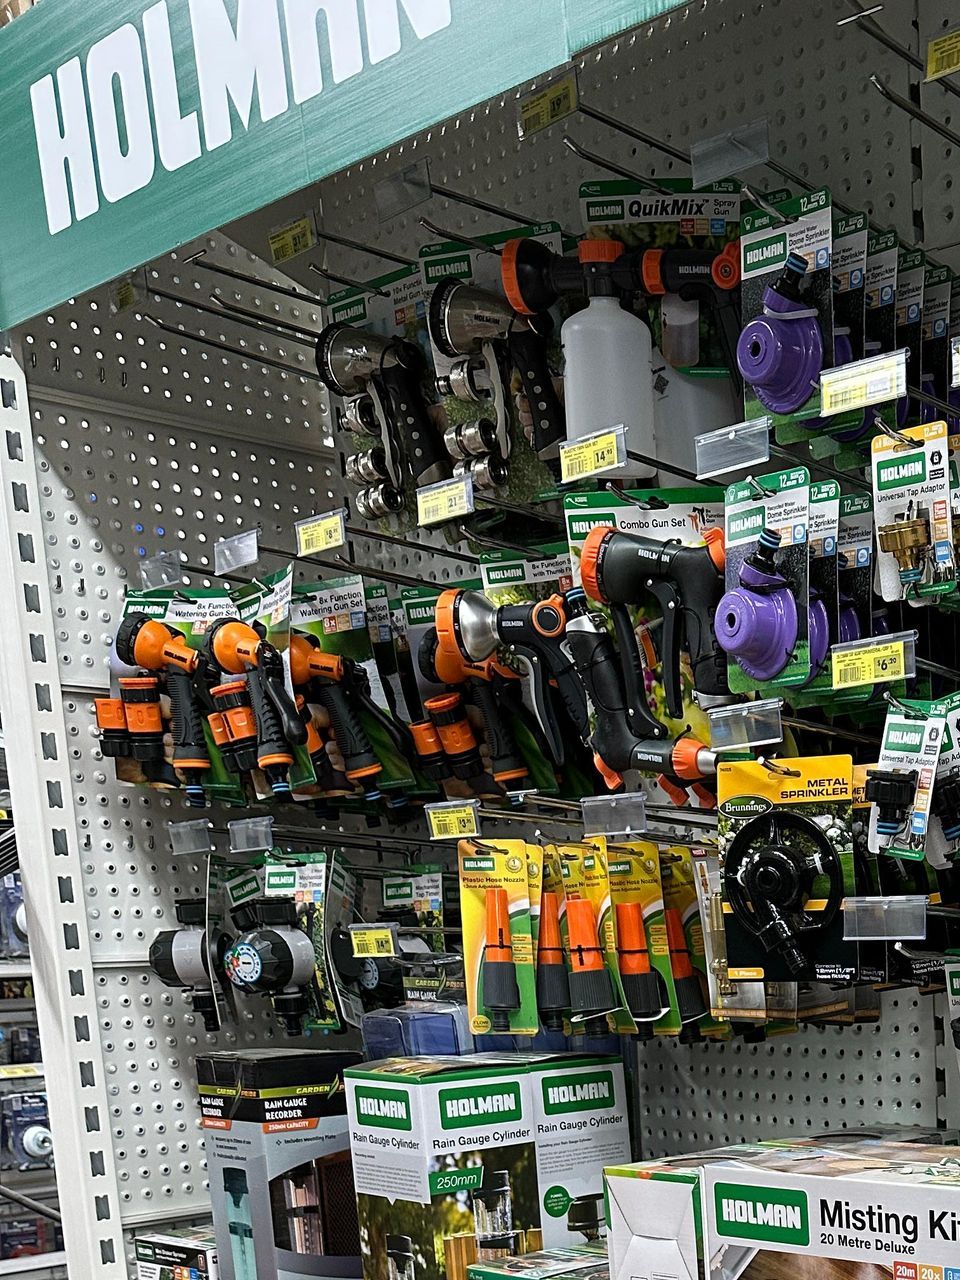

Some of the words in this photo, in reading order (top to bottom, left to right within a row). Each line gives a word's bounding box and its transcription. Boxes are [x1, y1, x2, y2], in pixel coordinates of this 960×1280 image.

[589, 204, 622, 218] HOLMAN
[628, 199, 705, 218] QuikMix
[713, 199, 737, 210] Spray
[713, 208, 730, 216] Gun
[746, 241, 784, 264] HOLMAN
[880, 460, 923, 482] HOLMAN
[729, 512, 762, 534] HOLMAN
[319, 594, 329, 604] 8x
[330, 590, 362, 602] Function
[300, 604, 332, 618] Watering
[334, 602, 348, 612] Gun
[350, 599, 363, 610] Set
[807, 778, 848, 788] METAL
[780, 788, 849, 799] SPRINKLER
[724, 801, 767, 813] Brunnings
[547, 1081, 609, 1104] HOLMAN
[266, 1109, 302, 1119] RECORDER
[359, 1096, 407, 1119] HOLMAN
[446, 1092, 516, 1117] HOLMAN
[537, 1121, 557, 1134] Rain
[559, 1119, 589, 1132] Gauge
[591, 1114, 623, 1128] Cylinder
[432, 1137, 454, 1149] Rain
[456, 1134, 489, 1148] Gauge
[492, 1128, 530, 1144] Cylinder
[437, 1172, 478, 1188] 250mm
[722, 1198, 801, 1229] HOLMAN
[819, 1199, 919, 1243] Misting
[820, 1233, 834, 1245] 20
[838, 1234, 872, 1249] Metre
[875, 1238, 915, 1254] Deluxe
